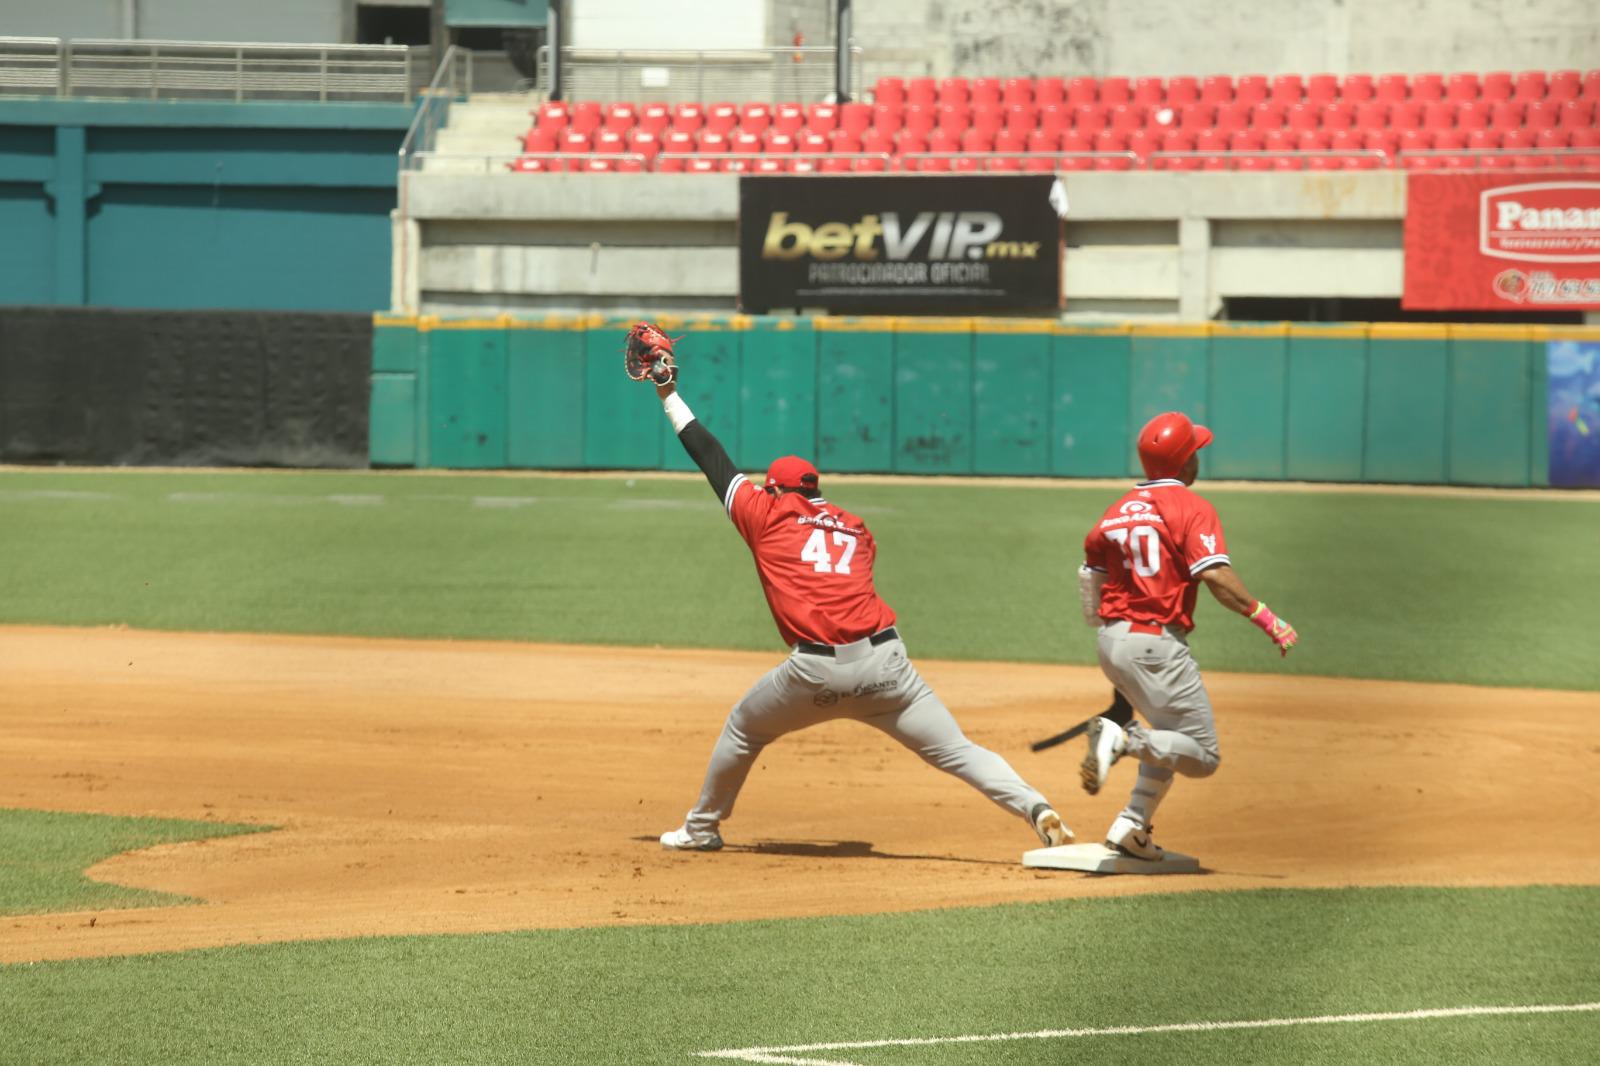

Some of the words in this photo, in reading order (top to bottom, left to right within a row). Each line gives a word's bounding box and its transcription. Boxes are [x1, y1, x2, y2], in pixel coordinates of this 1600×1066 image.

[761, 211, 1041, 260] betVIP.mx
[808, 262, 927, 284] PATROCINADOR
[931, 262, 989, 284] OFICIAL
[801, 528, 857, 575] 47
